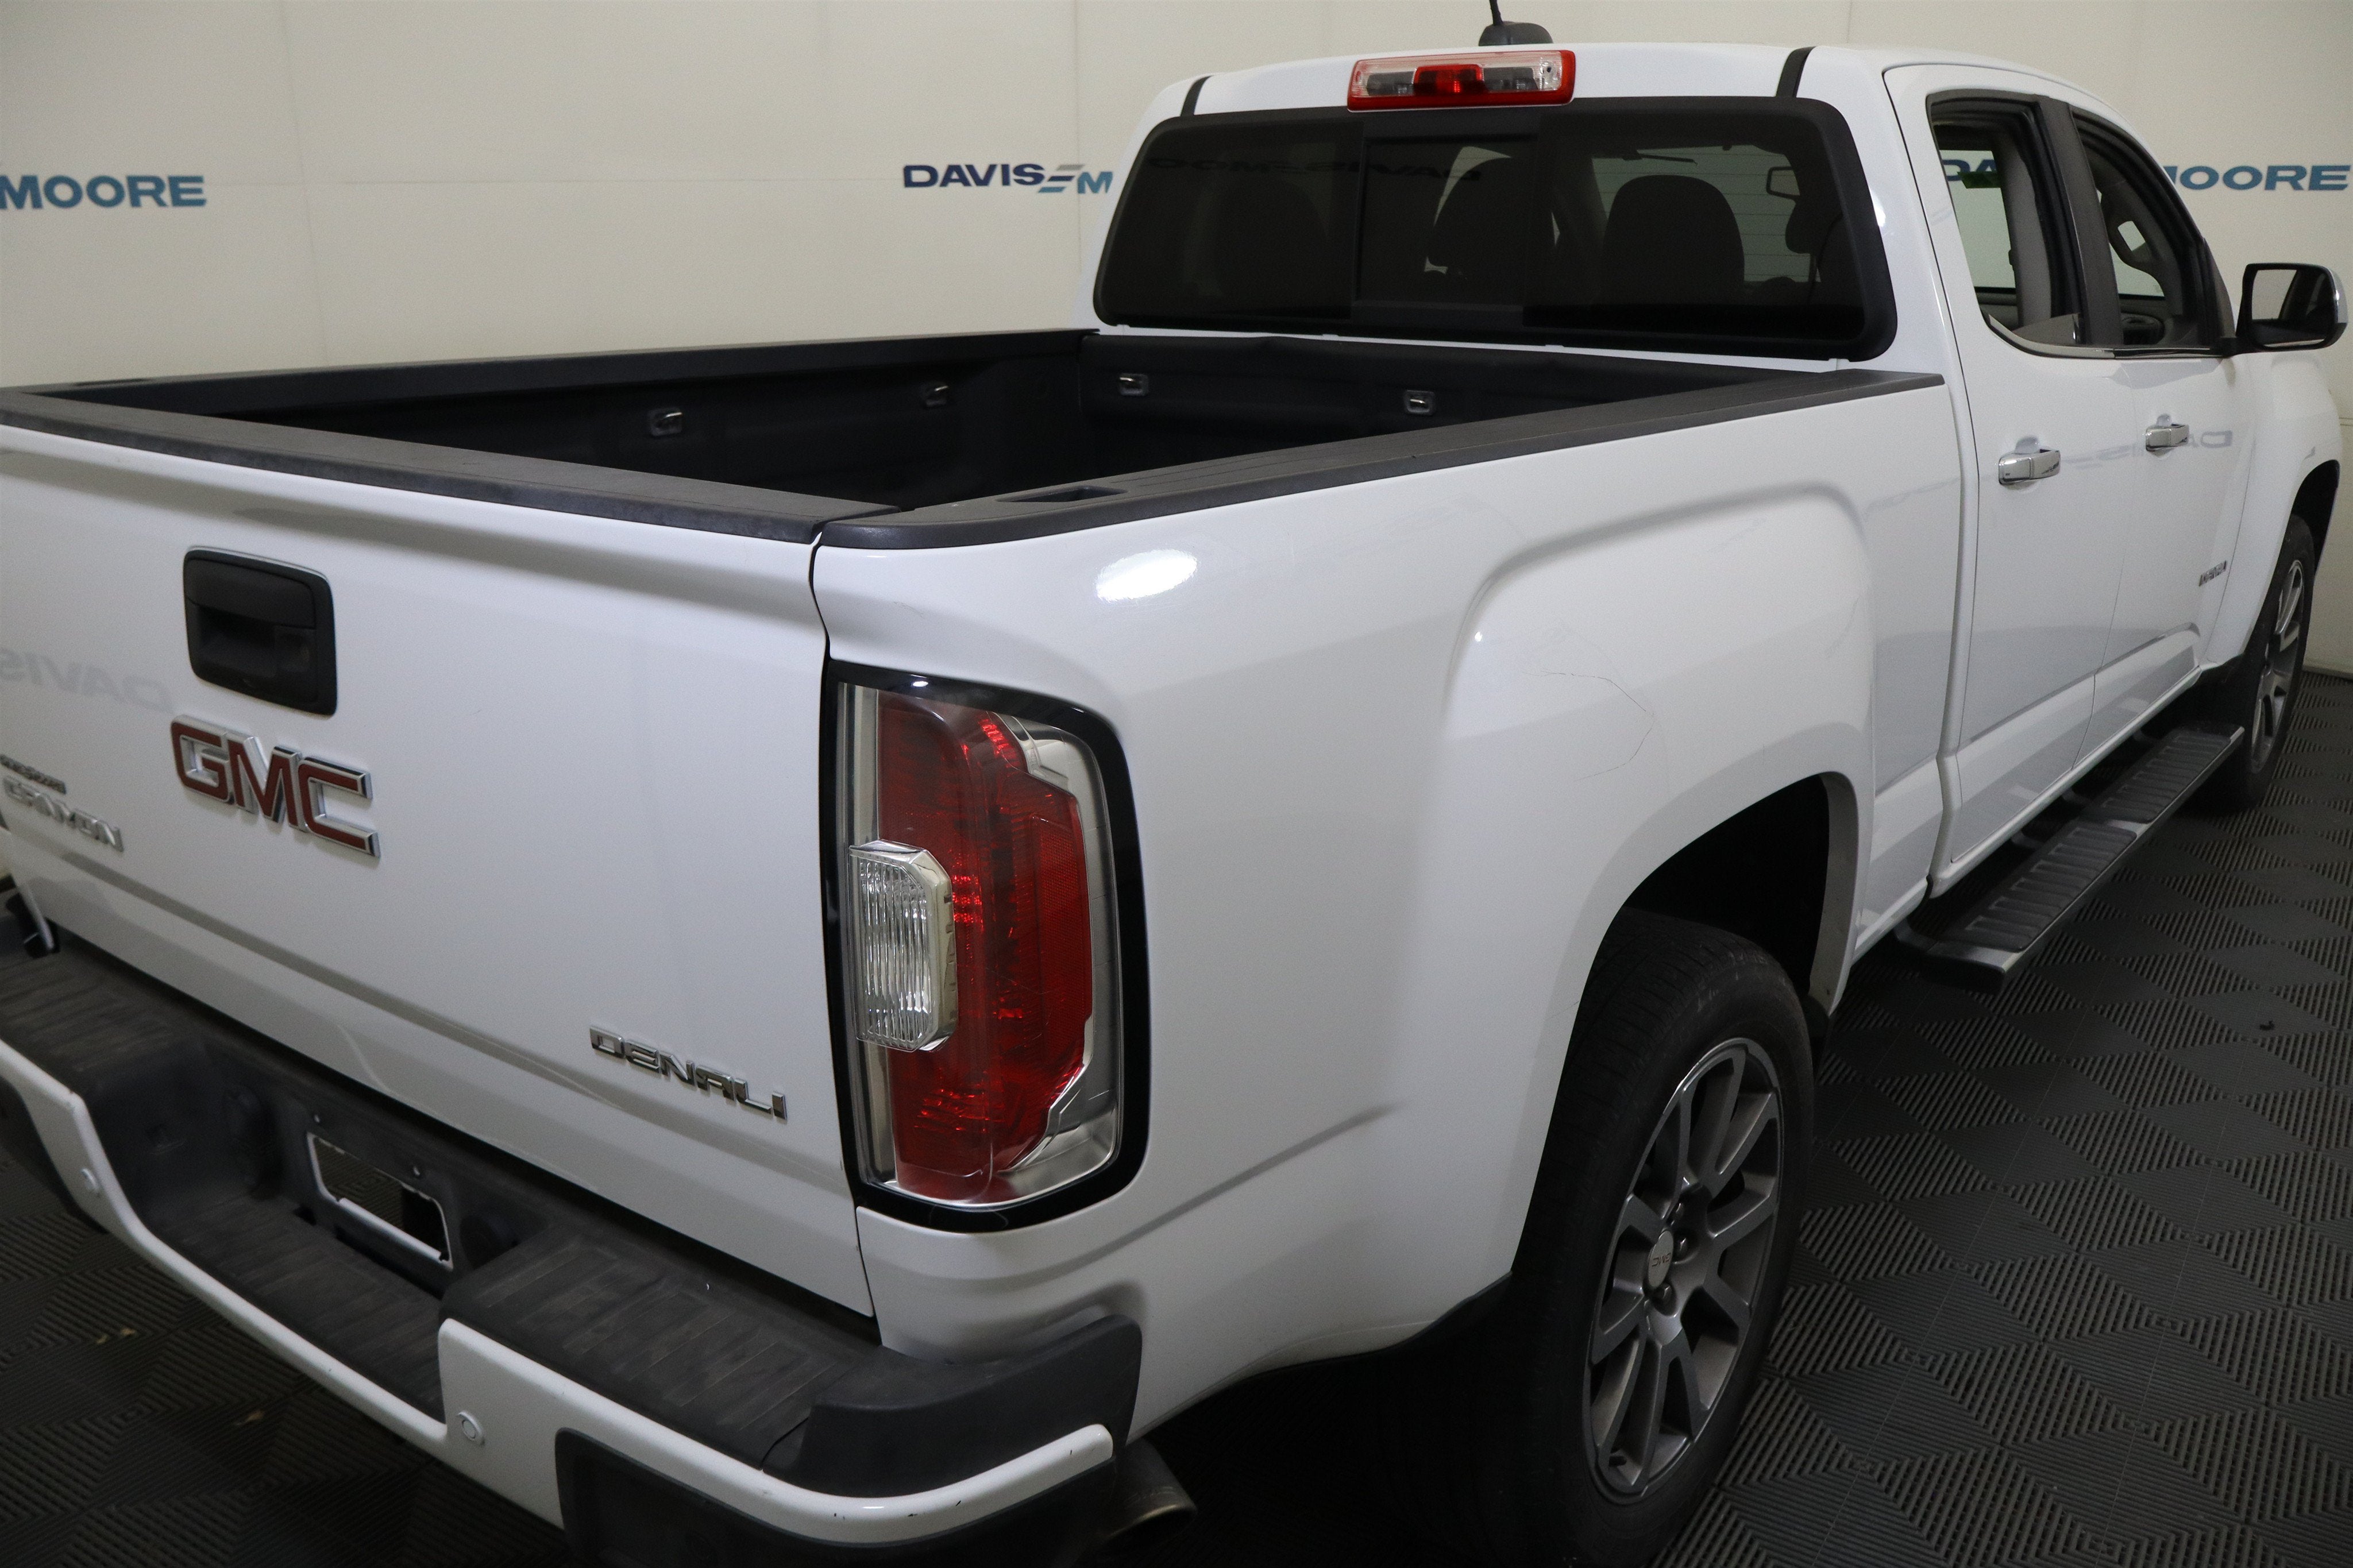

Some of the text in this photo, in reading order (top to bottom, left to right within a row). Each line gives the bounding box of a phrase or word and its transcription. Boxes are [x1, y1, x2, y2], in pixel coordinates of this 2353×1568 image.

[0, 174, 207, 209] MOORE
[902, 163, 1045, 188] DAVIS
[171, 714, 381, 860] GMC
[589, 1025, 788, 1120] DENALI
